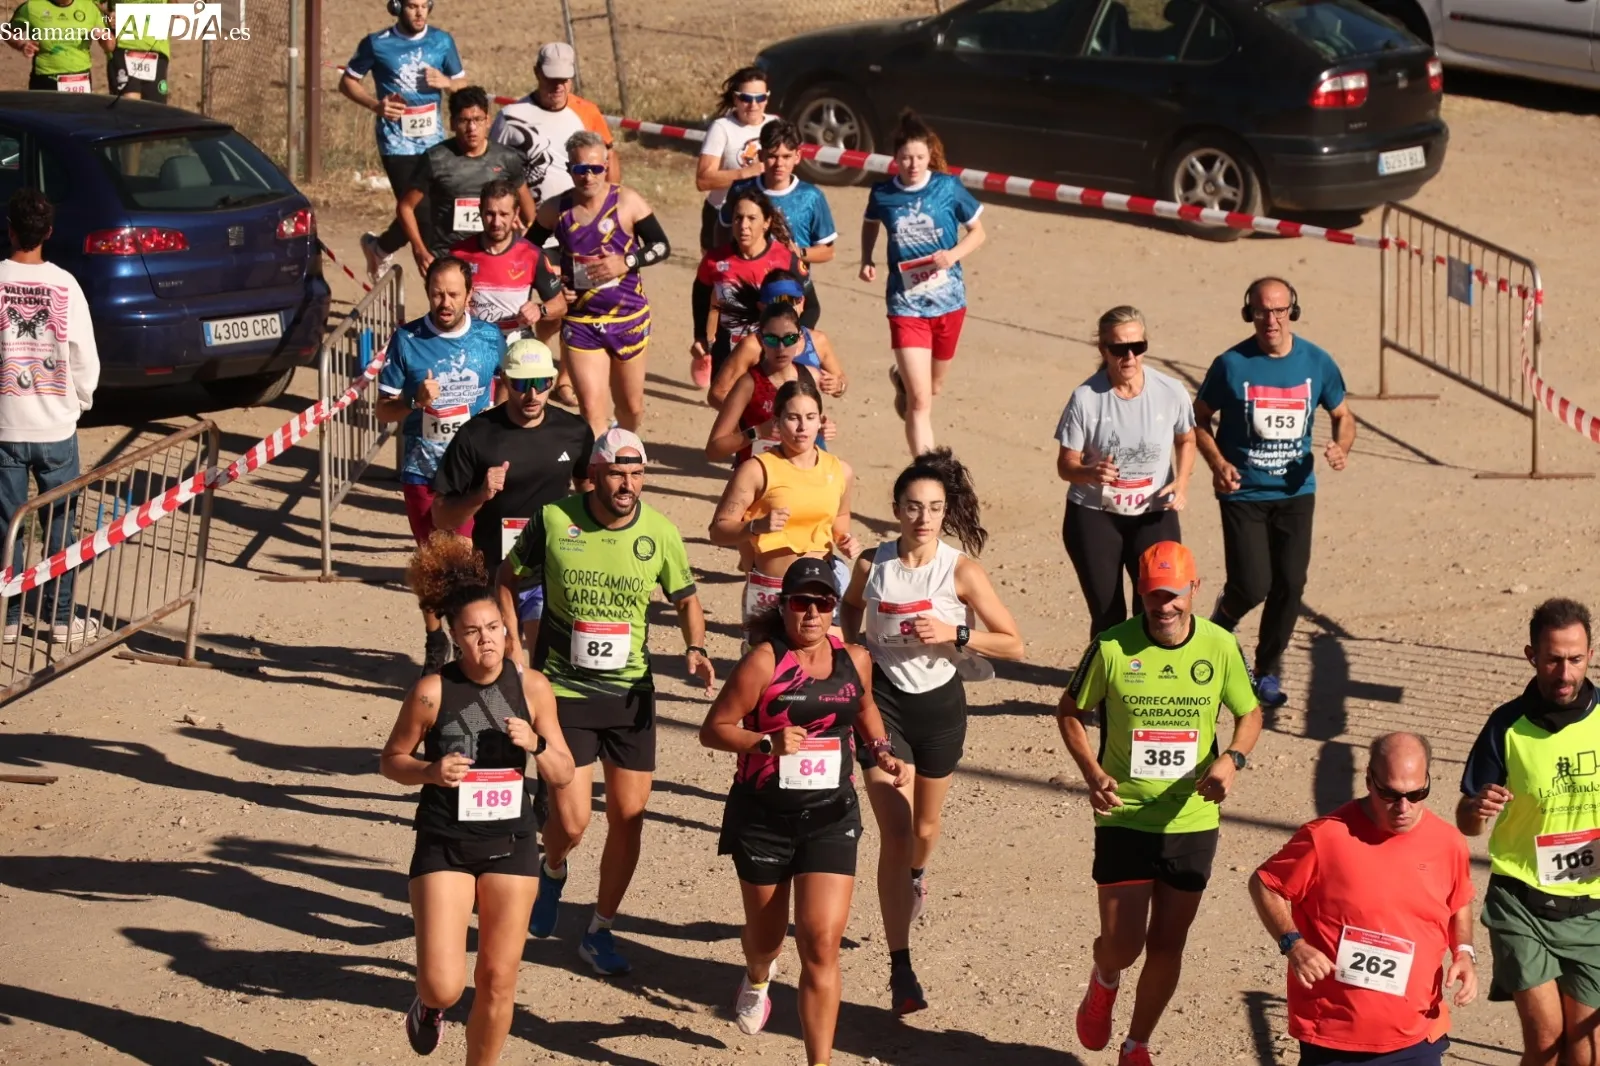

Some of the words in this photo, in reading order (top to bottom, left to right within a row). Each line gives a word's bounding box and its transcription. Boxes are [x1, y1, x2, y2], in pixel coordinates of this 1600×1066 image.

[131, 62, 151, 73] 386
[410, 117, 432, 129] 228
[910, 269, 939, 285] 395
[4, 286, 51, 296] VALUABLE
[4, 296, 51, 306] PRESENCE
[214, 320, 249, 341] 4309
[252, 317, 278, 337] CRC
[431, 421, 461, 434] 165
[1264, 415, 1296, 429] 153
[1112, 493, 1145, 506] 110
[563, 568, 644, 593] CORRECAMINOS
[563, 587, 637, 607] CARBAJOSA
[567, 604, 634, 619] SALAMANCA
[587, 640, 613, 658] 82
[1122, 694, 1212, 706] CORRECAMINOS
[1132, 707, 1200, 718] CARBAJOSA
[1144, 749, 1185, 766] 385
[799, 758, 826, 776] 84
[472, 789, 512, 807] 189
[1552, 848, 1595, 870] 106
[1349, 952, 1397, 979] 262
